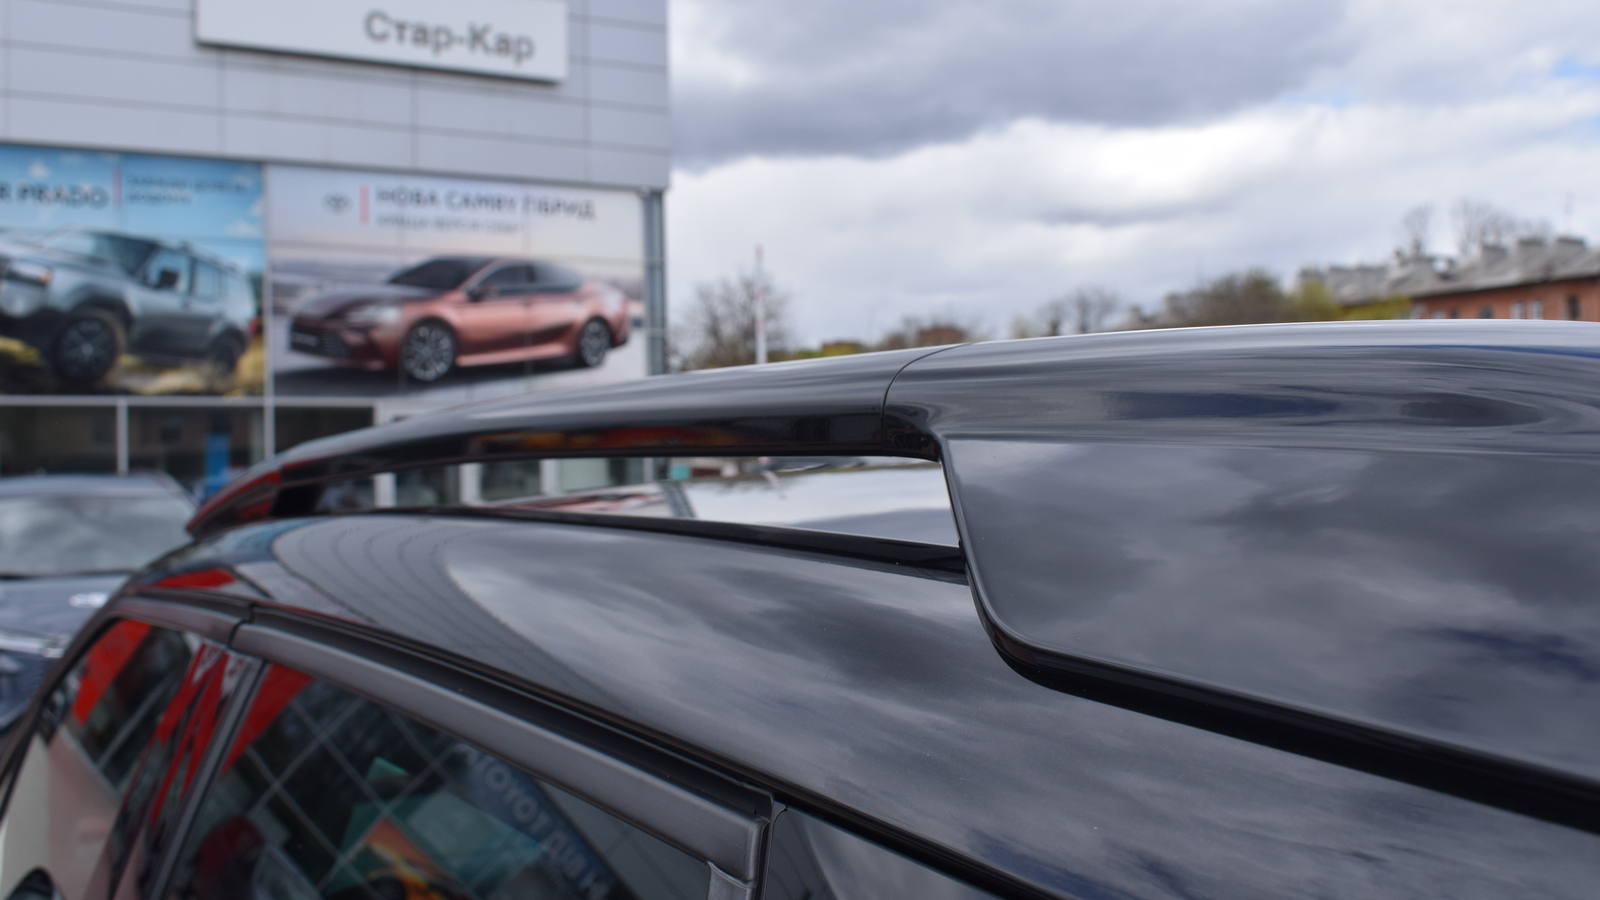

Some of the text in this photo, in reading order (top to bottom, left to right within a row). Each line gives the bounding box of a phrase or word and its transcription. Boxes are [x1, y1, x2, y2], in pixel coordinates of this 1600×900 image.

[364, 11, 535, 65] Стар-Кар
[17, 183, 109, 209] PRADO
[377, 187, 597, 222] НОВА CAMRY ГІБРИД
